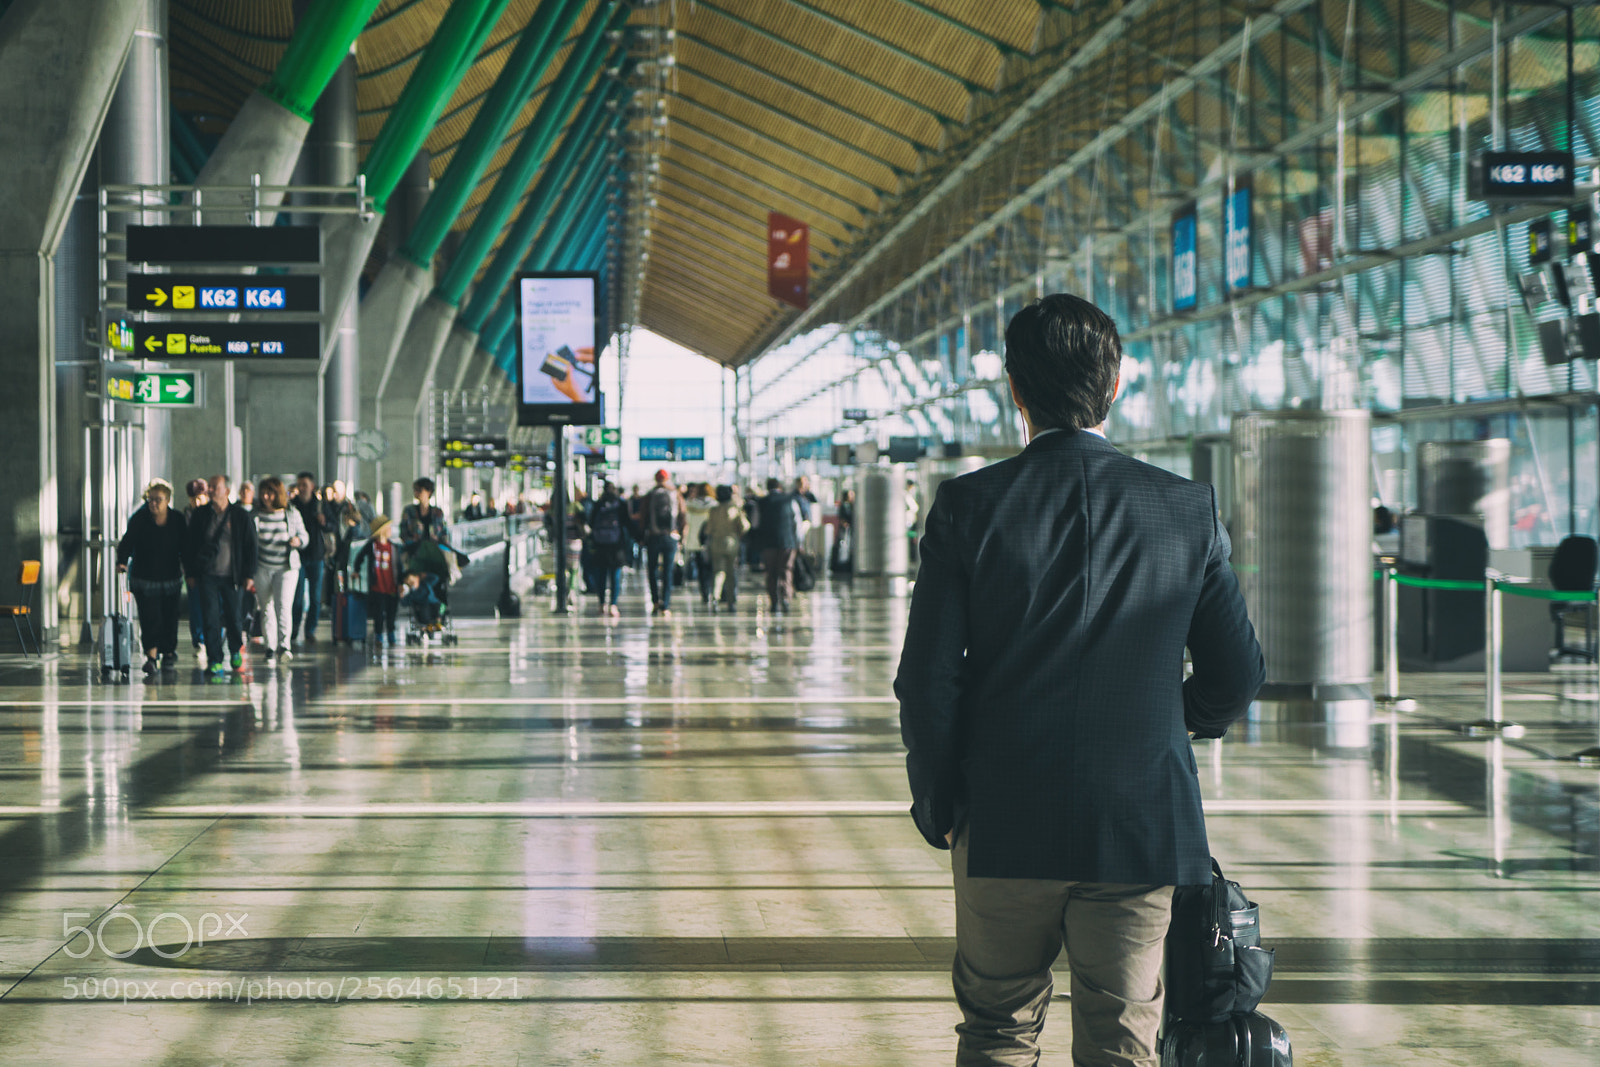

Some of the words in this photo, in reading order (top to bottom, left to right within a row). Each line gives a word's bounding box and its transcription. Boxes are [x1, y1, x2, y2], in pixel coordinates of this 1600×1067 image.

[1490, 164, 1525, 182] K62
[202, 289, 236, 306] K62
[246, 289, 282, 306] K64
[190, 343, 221, 353] Puertas
[263, 341, 283, 353] K71
